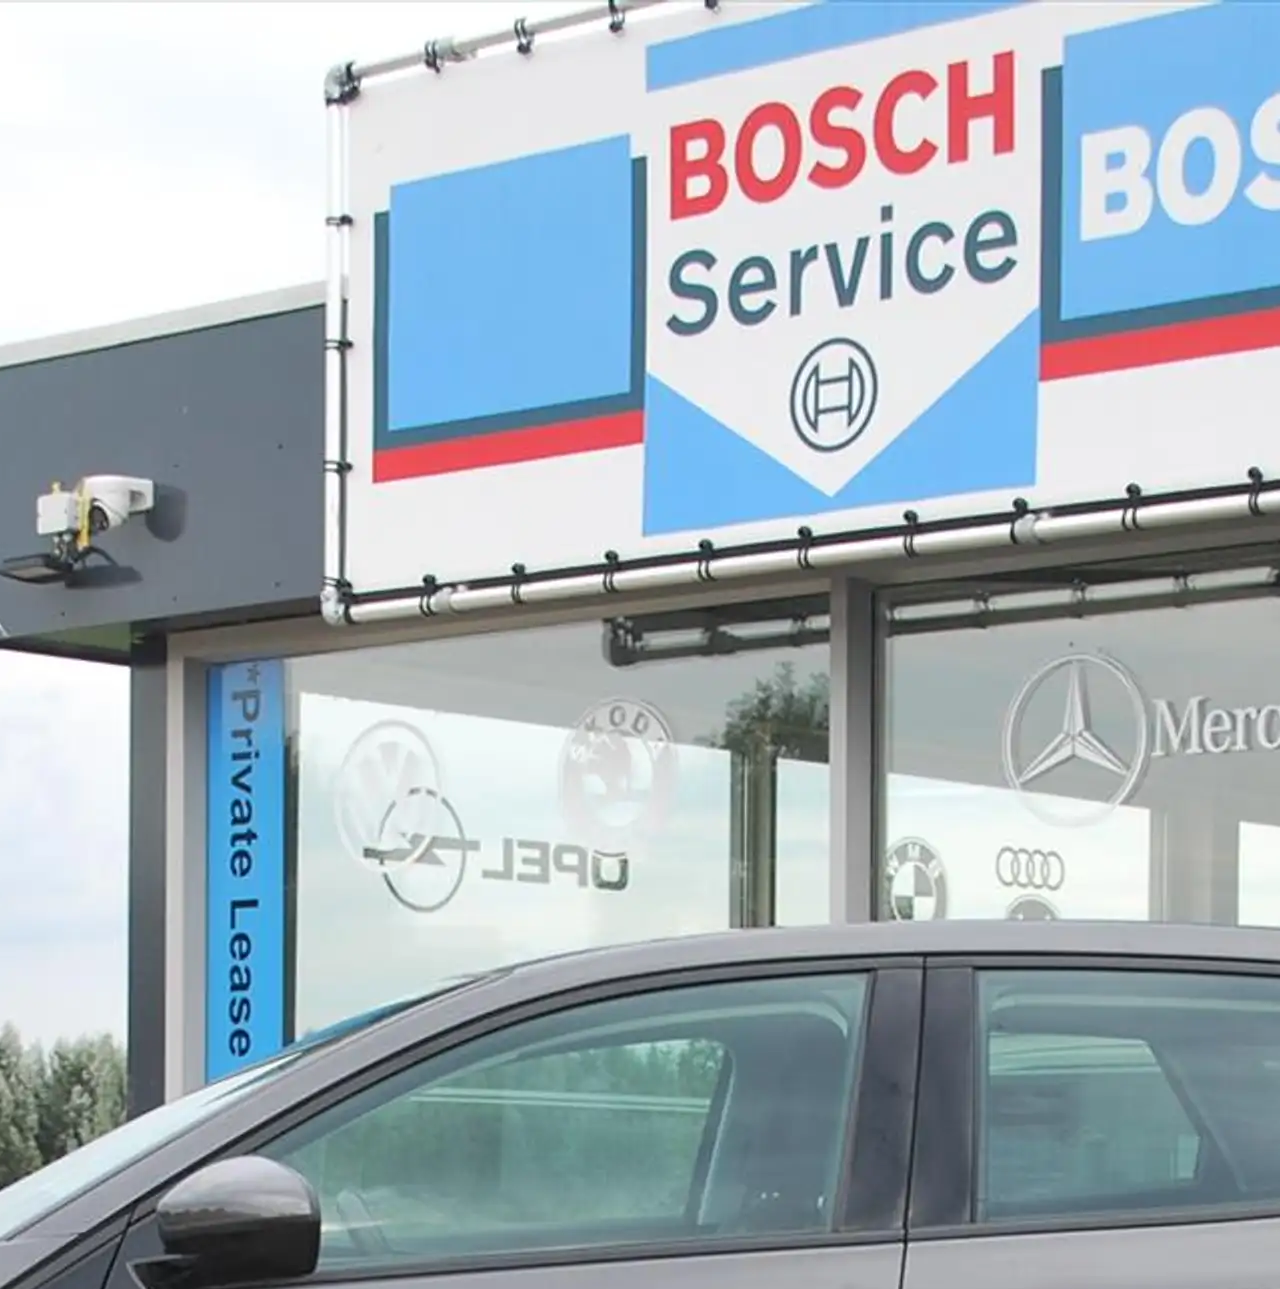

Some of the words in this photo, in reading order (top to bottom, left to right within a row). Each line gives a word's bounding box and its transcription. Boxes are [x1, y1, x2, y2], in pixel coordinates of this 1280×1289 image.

[669, 49, 1015, 222] BOSCH
[665, 204, 1019, 337] Service
[227, 898, 260, 1059] Lease
